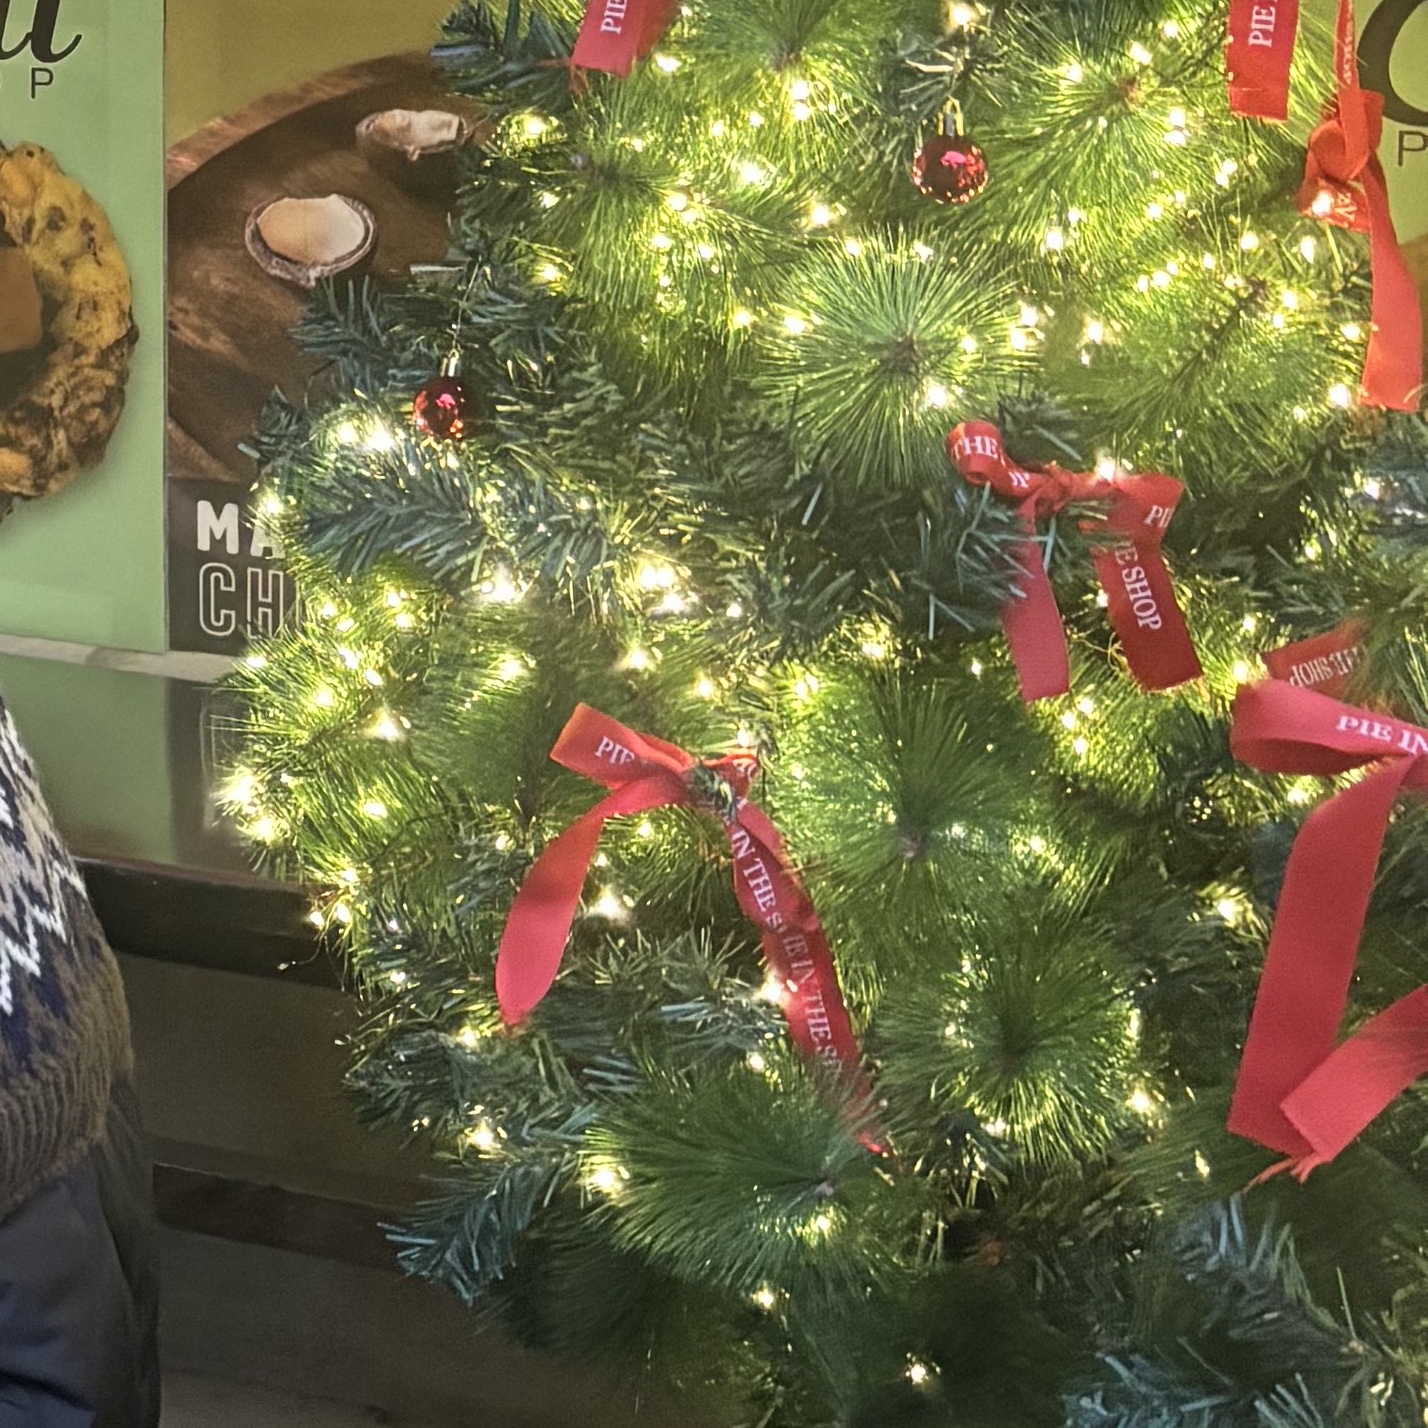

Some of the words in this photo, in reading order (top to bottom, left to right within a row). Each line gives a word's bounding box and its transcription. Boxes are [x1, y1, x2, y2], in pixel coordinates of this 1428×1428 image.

[1248, 1, 1275, 48] PIE
[1119, 567, 1163, 632] SHOP
[1336, 715, 1391, 742] PIE
[743, 857, 776, 913] THE
